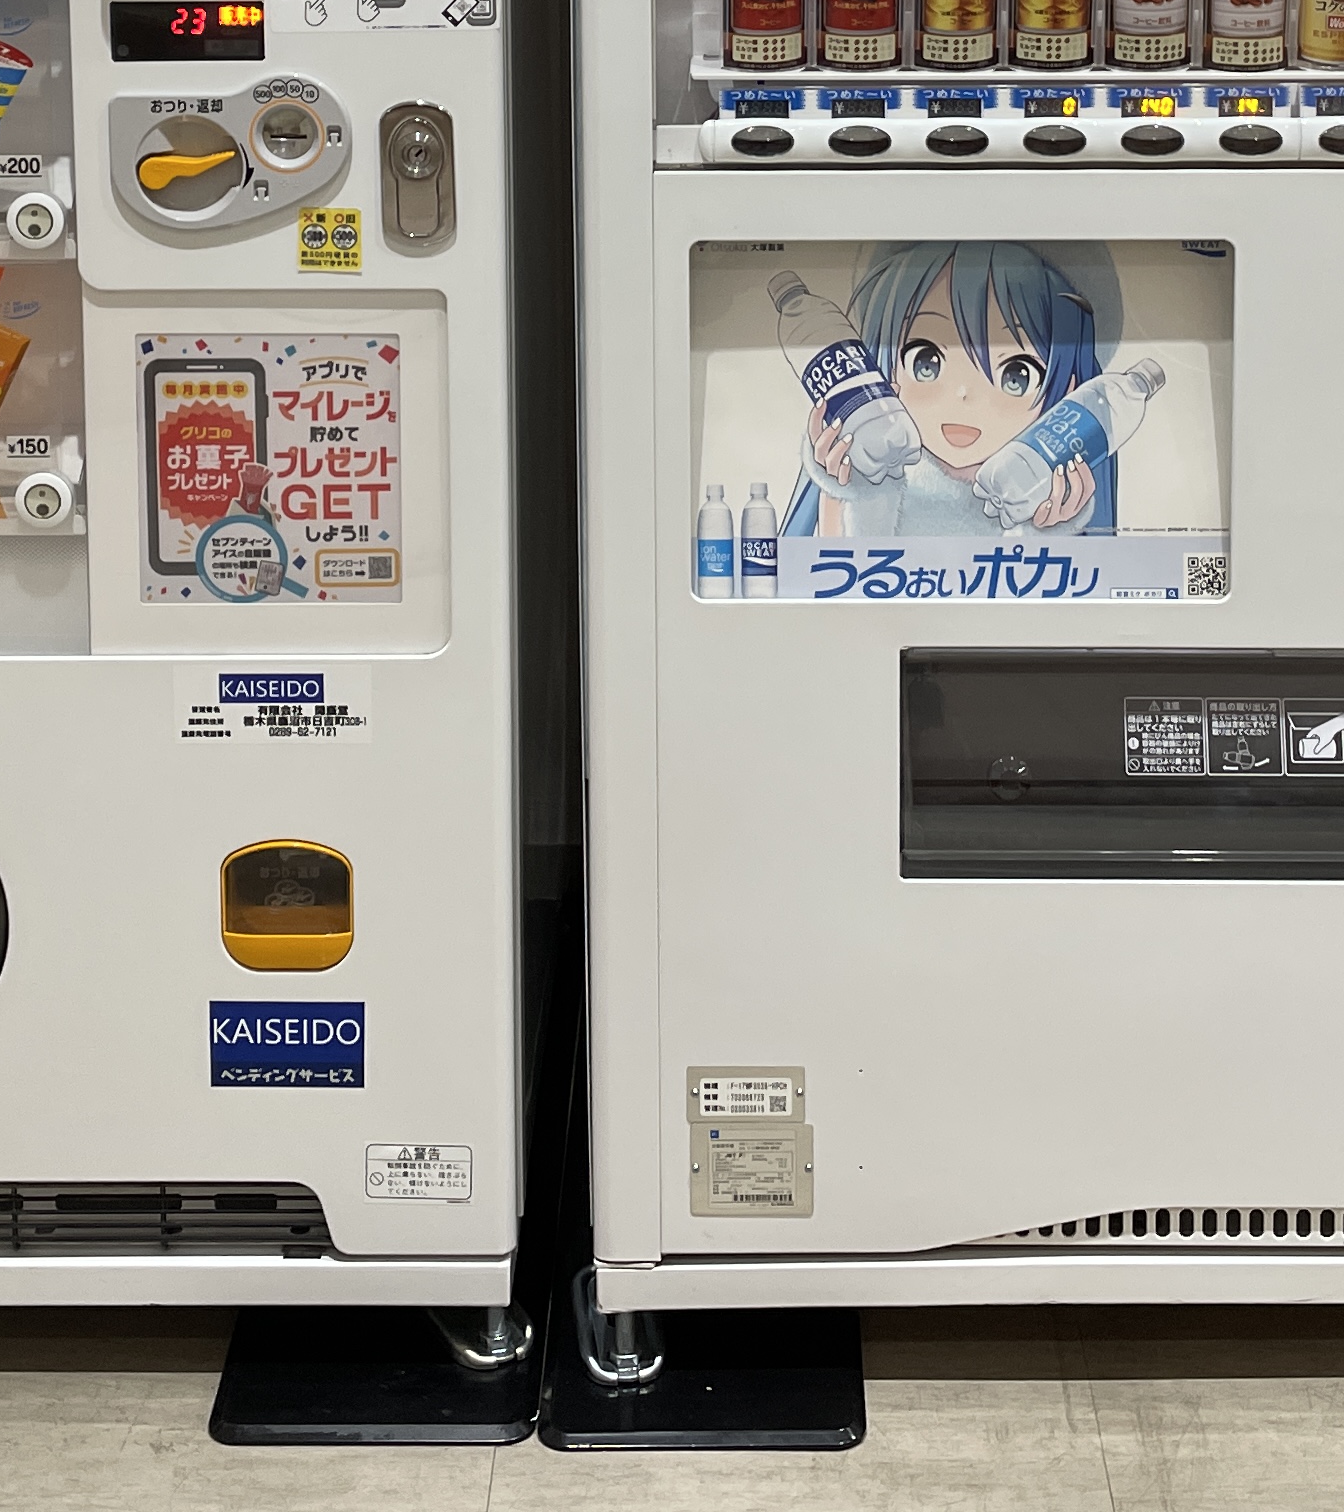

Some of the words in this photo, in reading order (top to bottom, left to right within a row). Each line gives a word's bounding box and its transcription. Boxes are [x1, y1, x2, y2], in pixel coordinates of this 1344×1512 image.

[171, 8, 207, 35] 23
[0, 156, 41, 174] ¥200
[302, 361, 367, 381] アプリで
[180, 427, 232, 439] グリコの
[310, 427, 359, 442] 貯めて
[8, 437, 49, 455] ¥150
[167, 445, 250, 469] お菓子
[275, 447, 398, 478] プレゼント
[167, 474, 232, 491] プレゼント
[281, 484, 391, 520] GET
[212, 538, 271, 547] セブンティーン
[810, 548, 1100, 600] うるおいポカリ
[222, 680, 319, 698] KAISEIDO
[213, 1018, 361, 1046] KAISEIDO
[221, 1068, 354, 1084] ベンディングサービス
